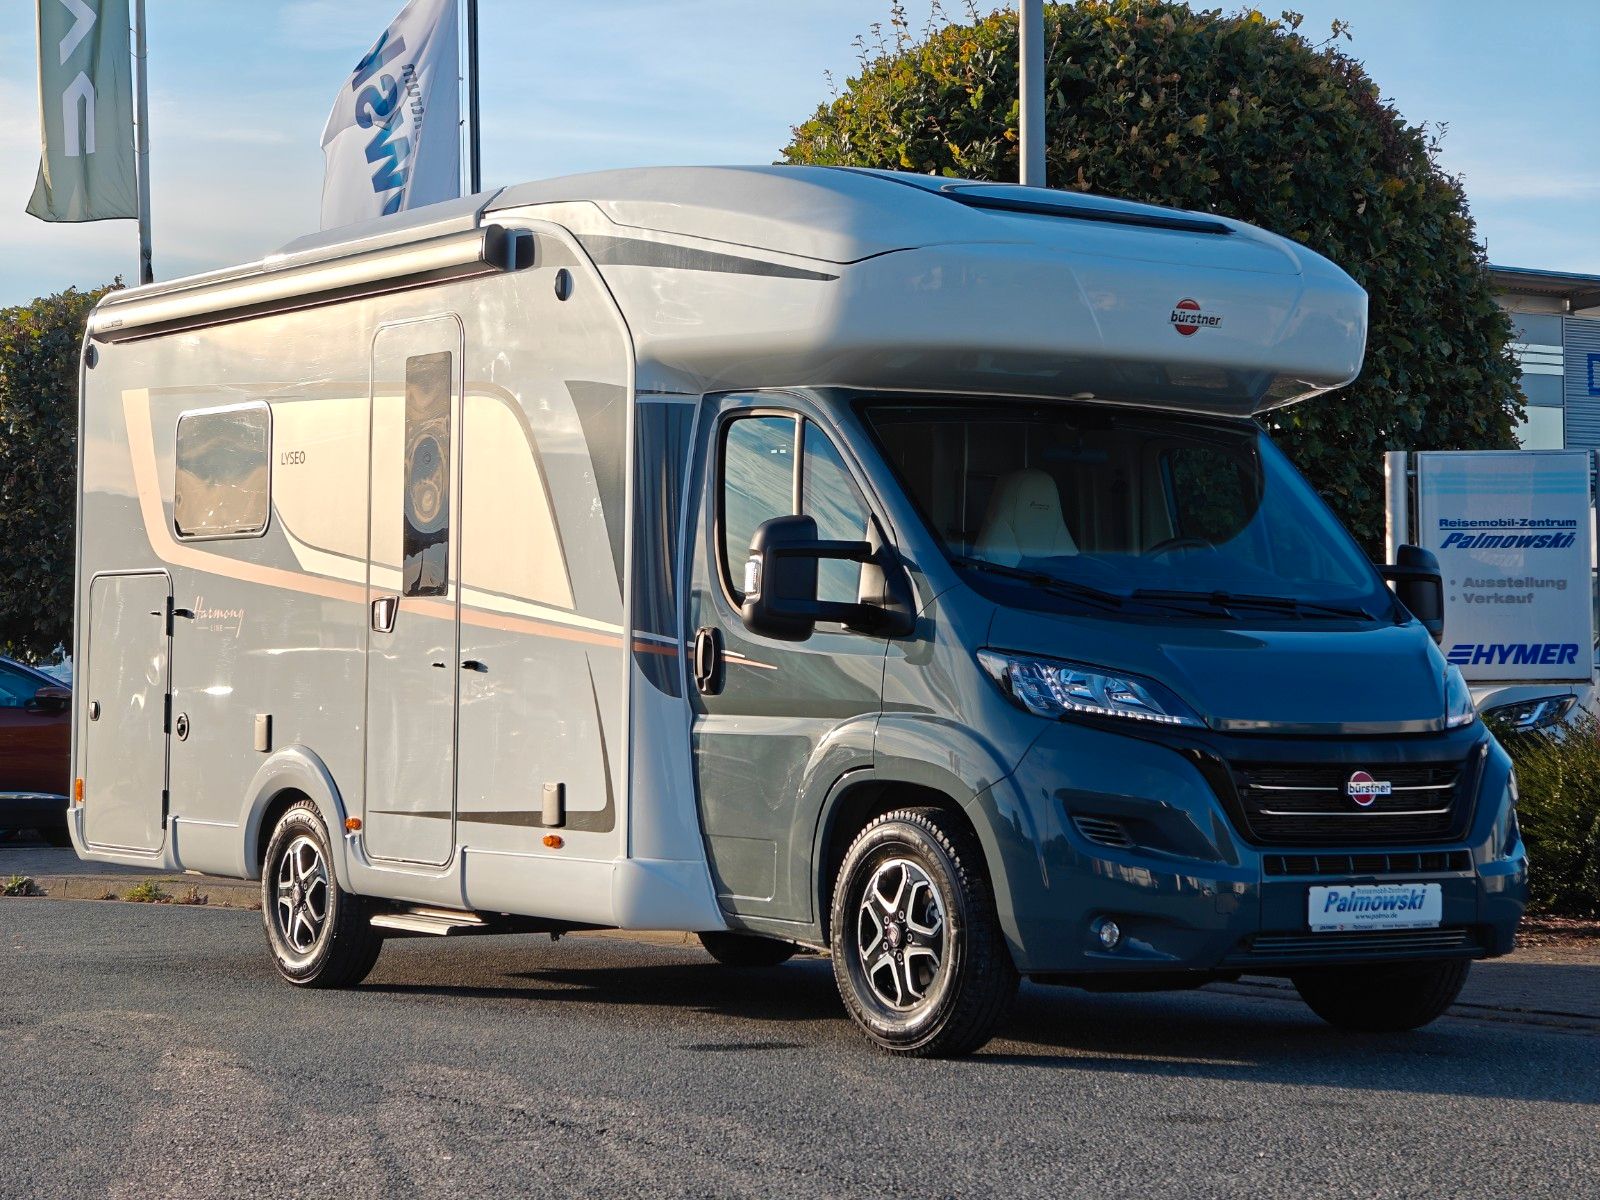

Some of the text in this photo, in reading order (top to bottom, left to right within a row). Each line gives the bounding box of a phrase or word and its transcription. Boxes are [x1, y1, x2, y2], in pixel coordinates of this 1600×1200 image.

[1170, 310, 1221, 326] bürstner
[281, 450, 306, 465] LYSEO
[1438, 518, 1577, 528] Reisemobil-Zentrum
[1439, 532, 1576, 549] Palmowski
[1462, 576, 1568, 591] Ausstellung
[1462, 592, 1535, 605] Verkauf
[191, 595, 245, 639] Harmony
[1471, 643, 1579, 665] HYMER
[1349, 783, 1390, 794] bürstner
[1324, 889, 1427, 913] Palmowski
